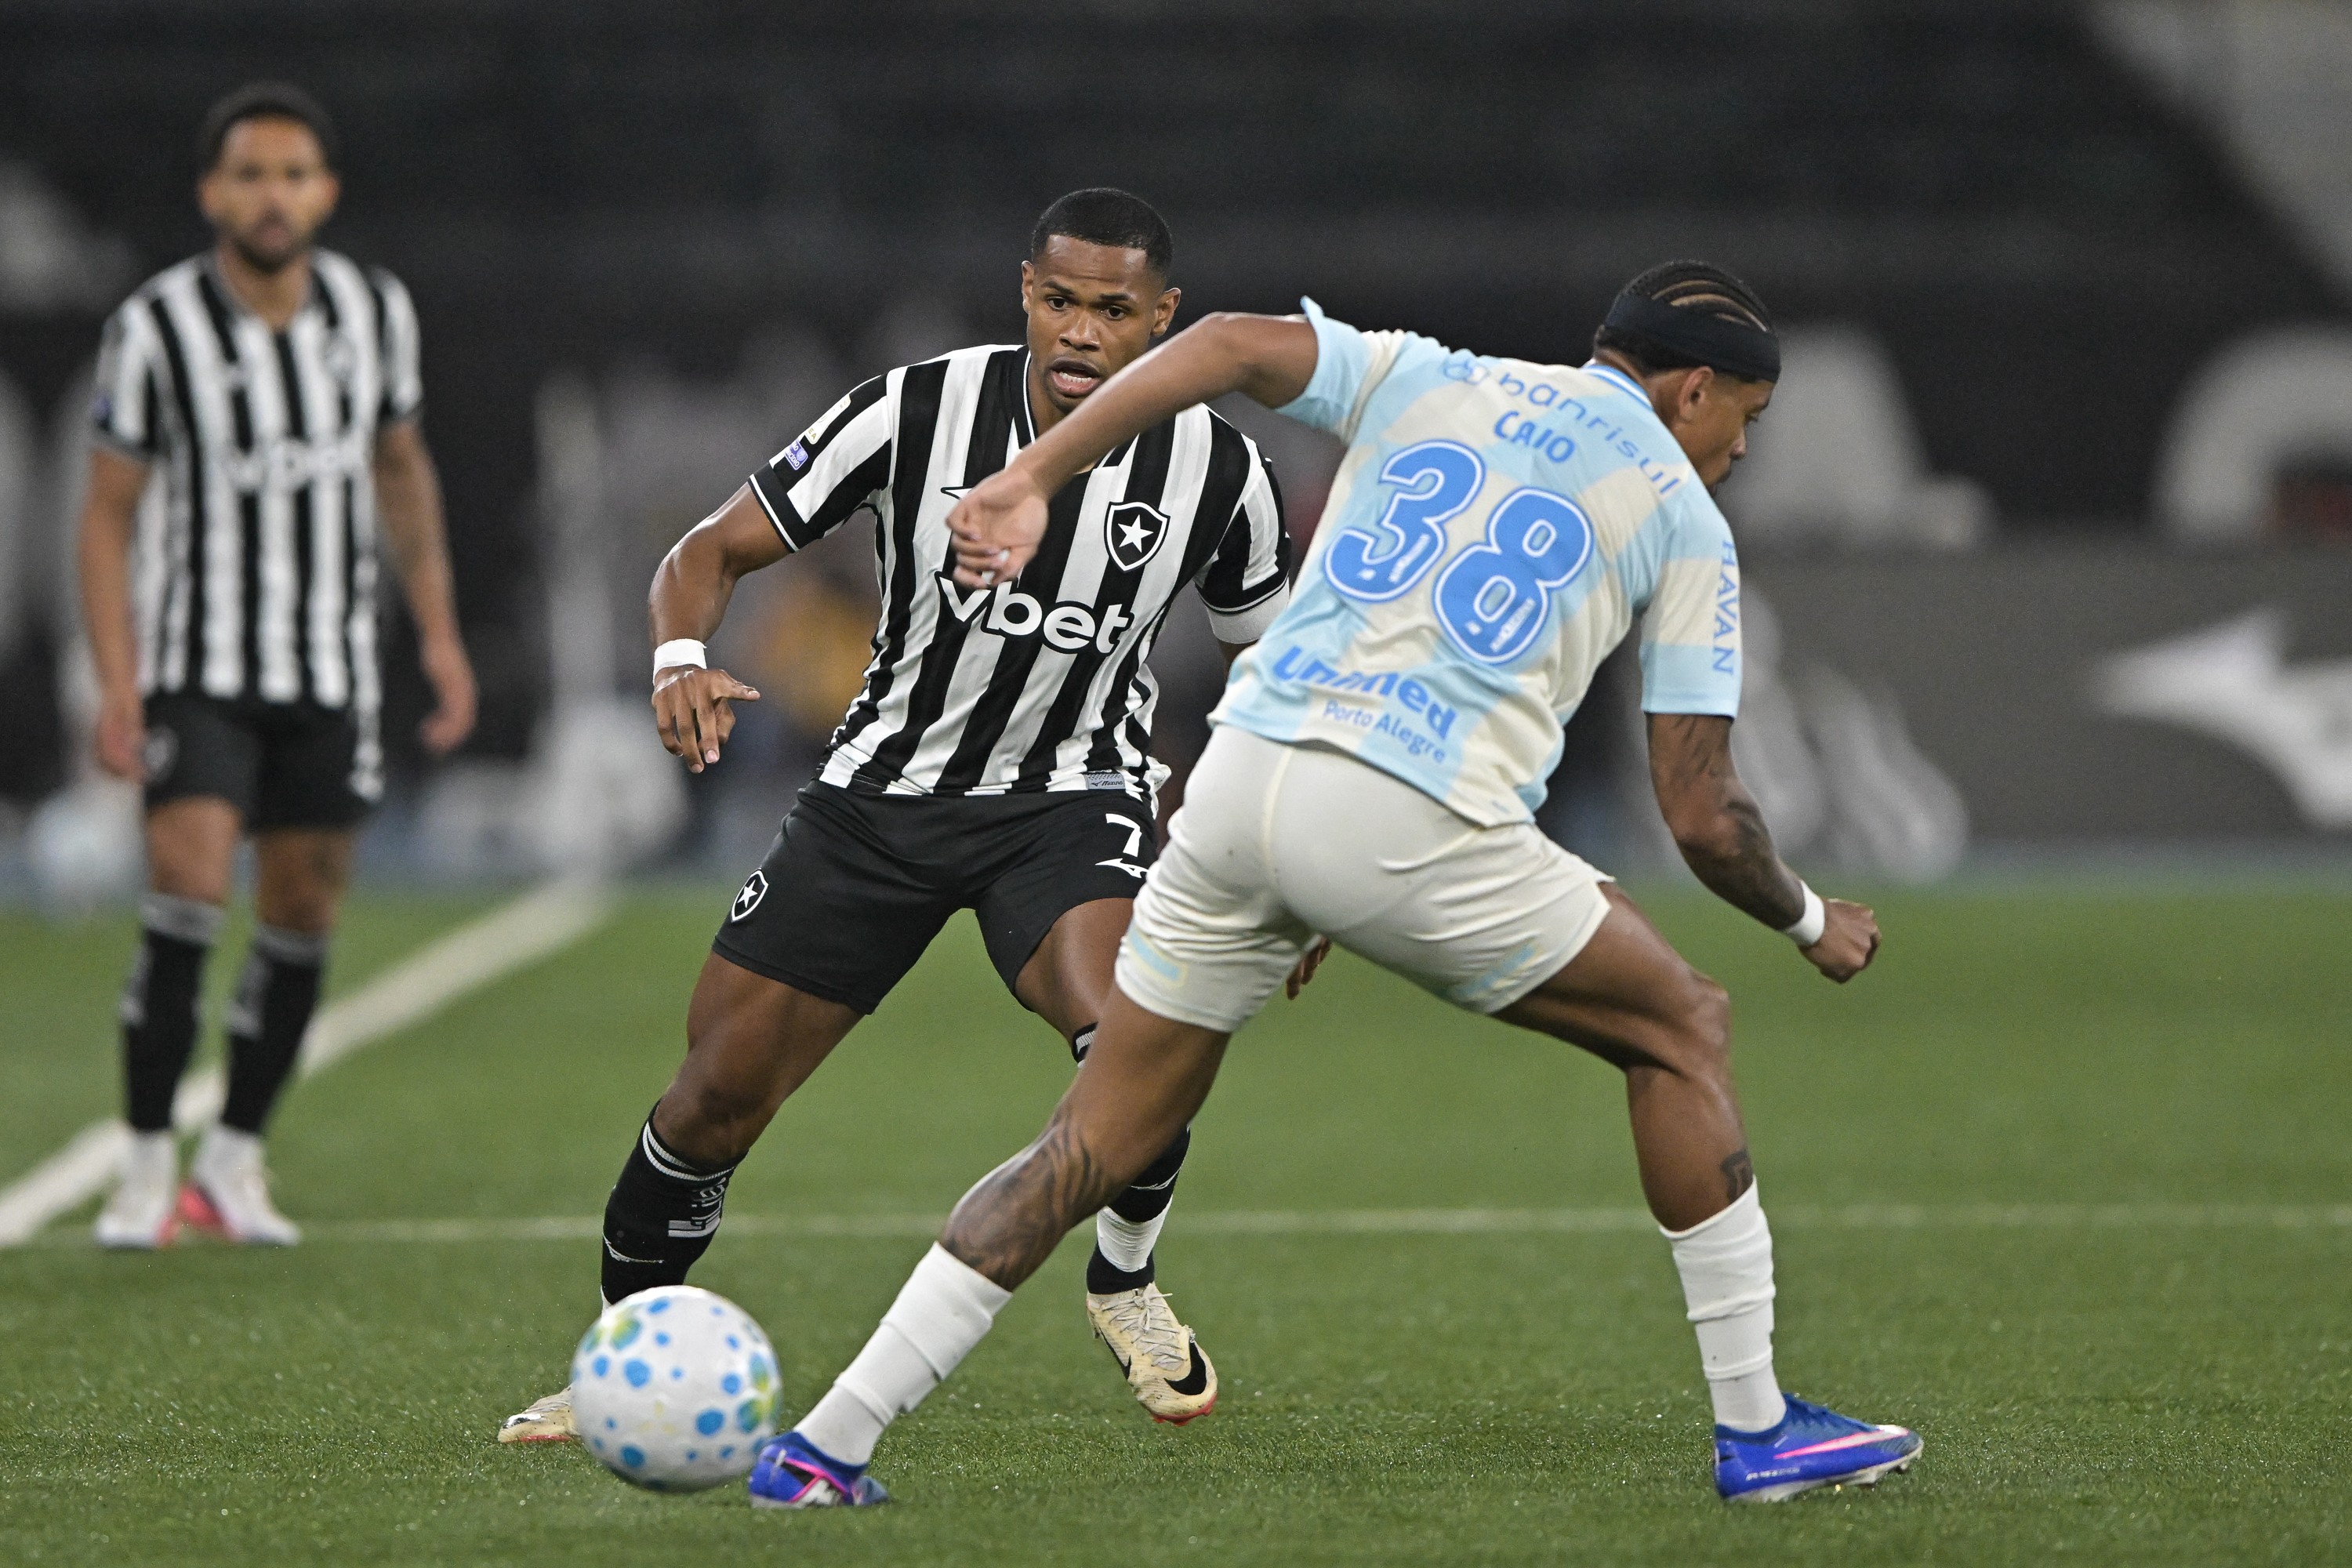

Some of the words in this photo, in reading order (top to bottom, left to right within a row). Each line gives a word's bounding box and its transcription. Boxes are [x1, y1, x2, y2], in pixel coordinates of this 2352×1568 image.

[1494, 411, 1576, 463] CAIO
[1498, 372, 1680, 495] banrisul
[1324, 438, 1594, 664] 38
[938, 576, 1131, 655] vbet
[1712, 539, 1738, 676] HAVAN
[1324, 699, 1374, 728] Porto
[1374, 713, 1446, 764] Alegre
[1105, 813, 1142, 858] 7
